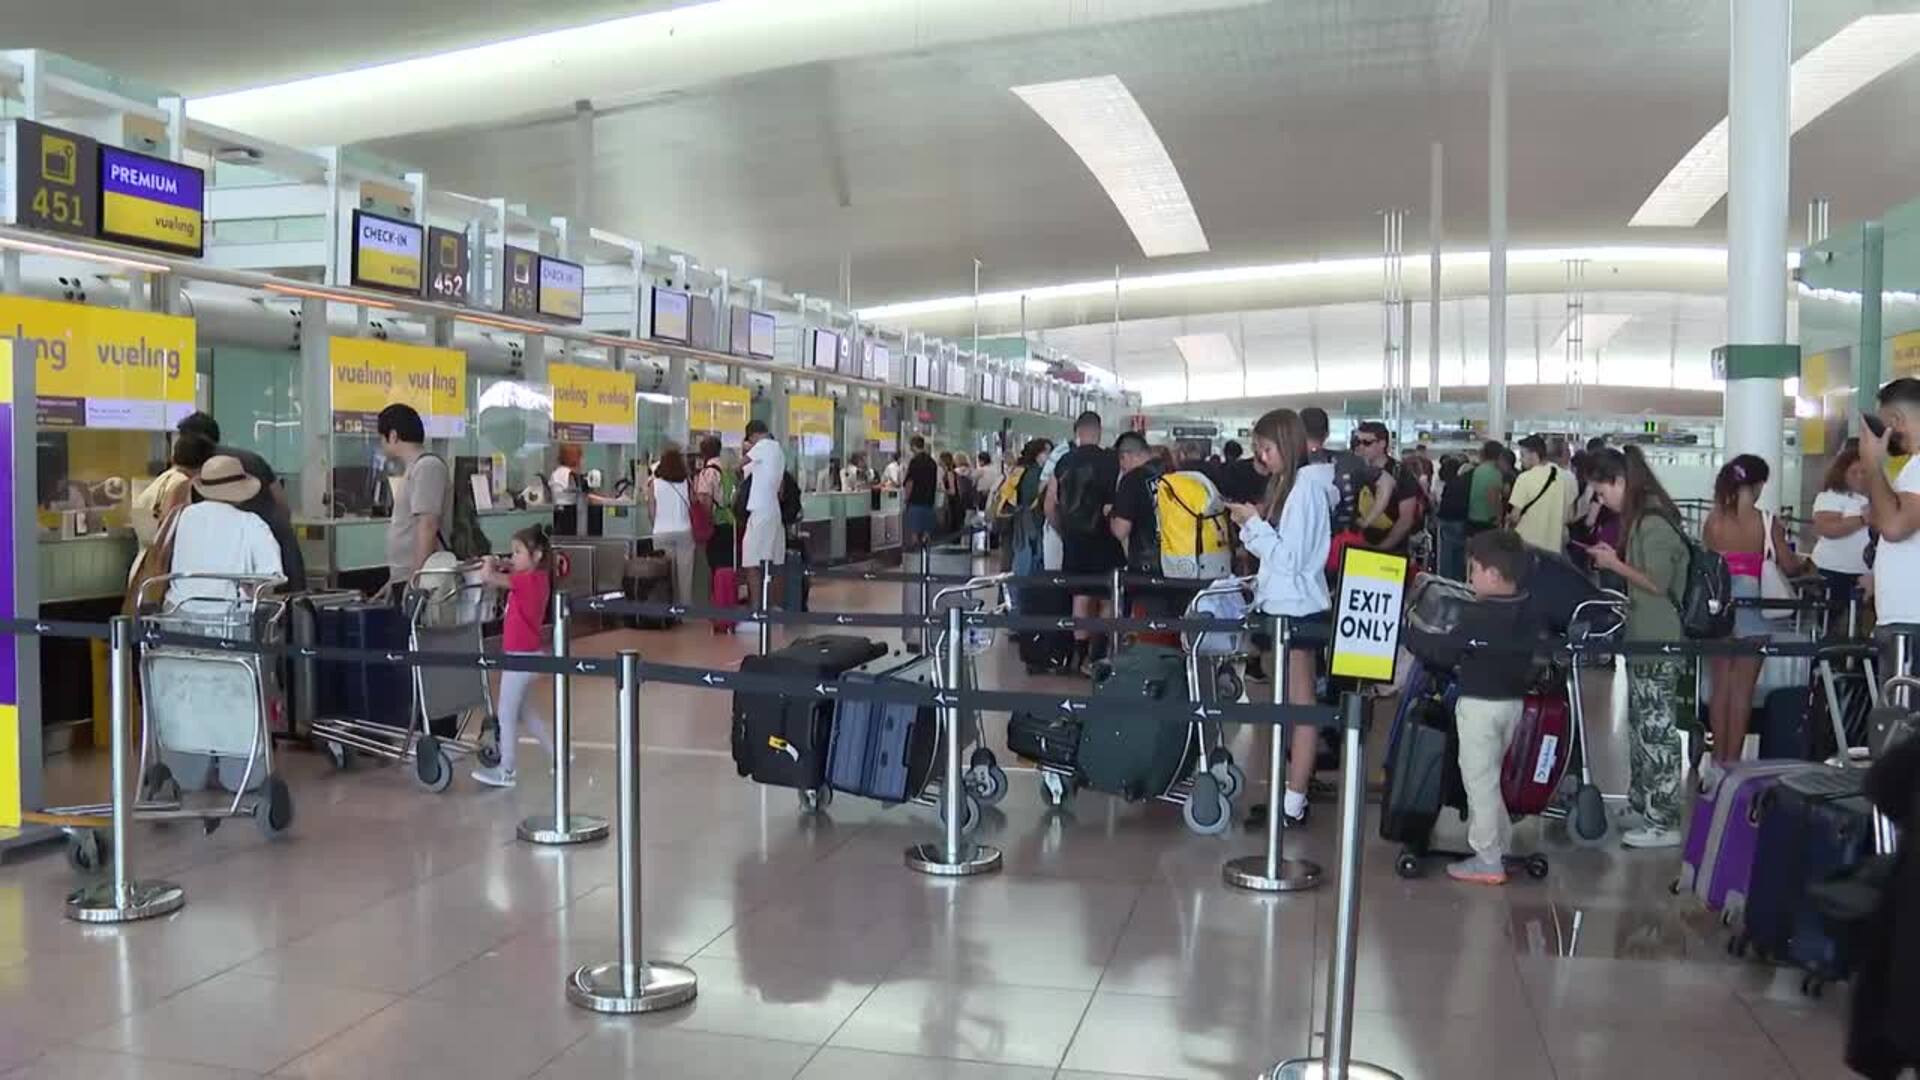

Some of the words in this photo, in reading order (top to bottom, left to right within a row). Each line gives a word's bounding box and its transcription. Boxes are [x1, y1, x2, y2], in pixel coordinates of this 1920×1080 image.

[111, 164, 178, 195] PREMIUM
[32, 187, 84, 227] 451
[154, 215, 195, 238] vueling
[362, 226, 408, 247] CHECK-IN
[434, 272, 463, 297] 452
[509, 286, 533, 309] 453
[97, 336, 181, 379] vueling
[336, 360, 393, 387] vueling
[408, 366, 457, 397] vueling
[1348, 588, 1393, 614] EXIT
[1340, 616, 1395, 643] ONLY
